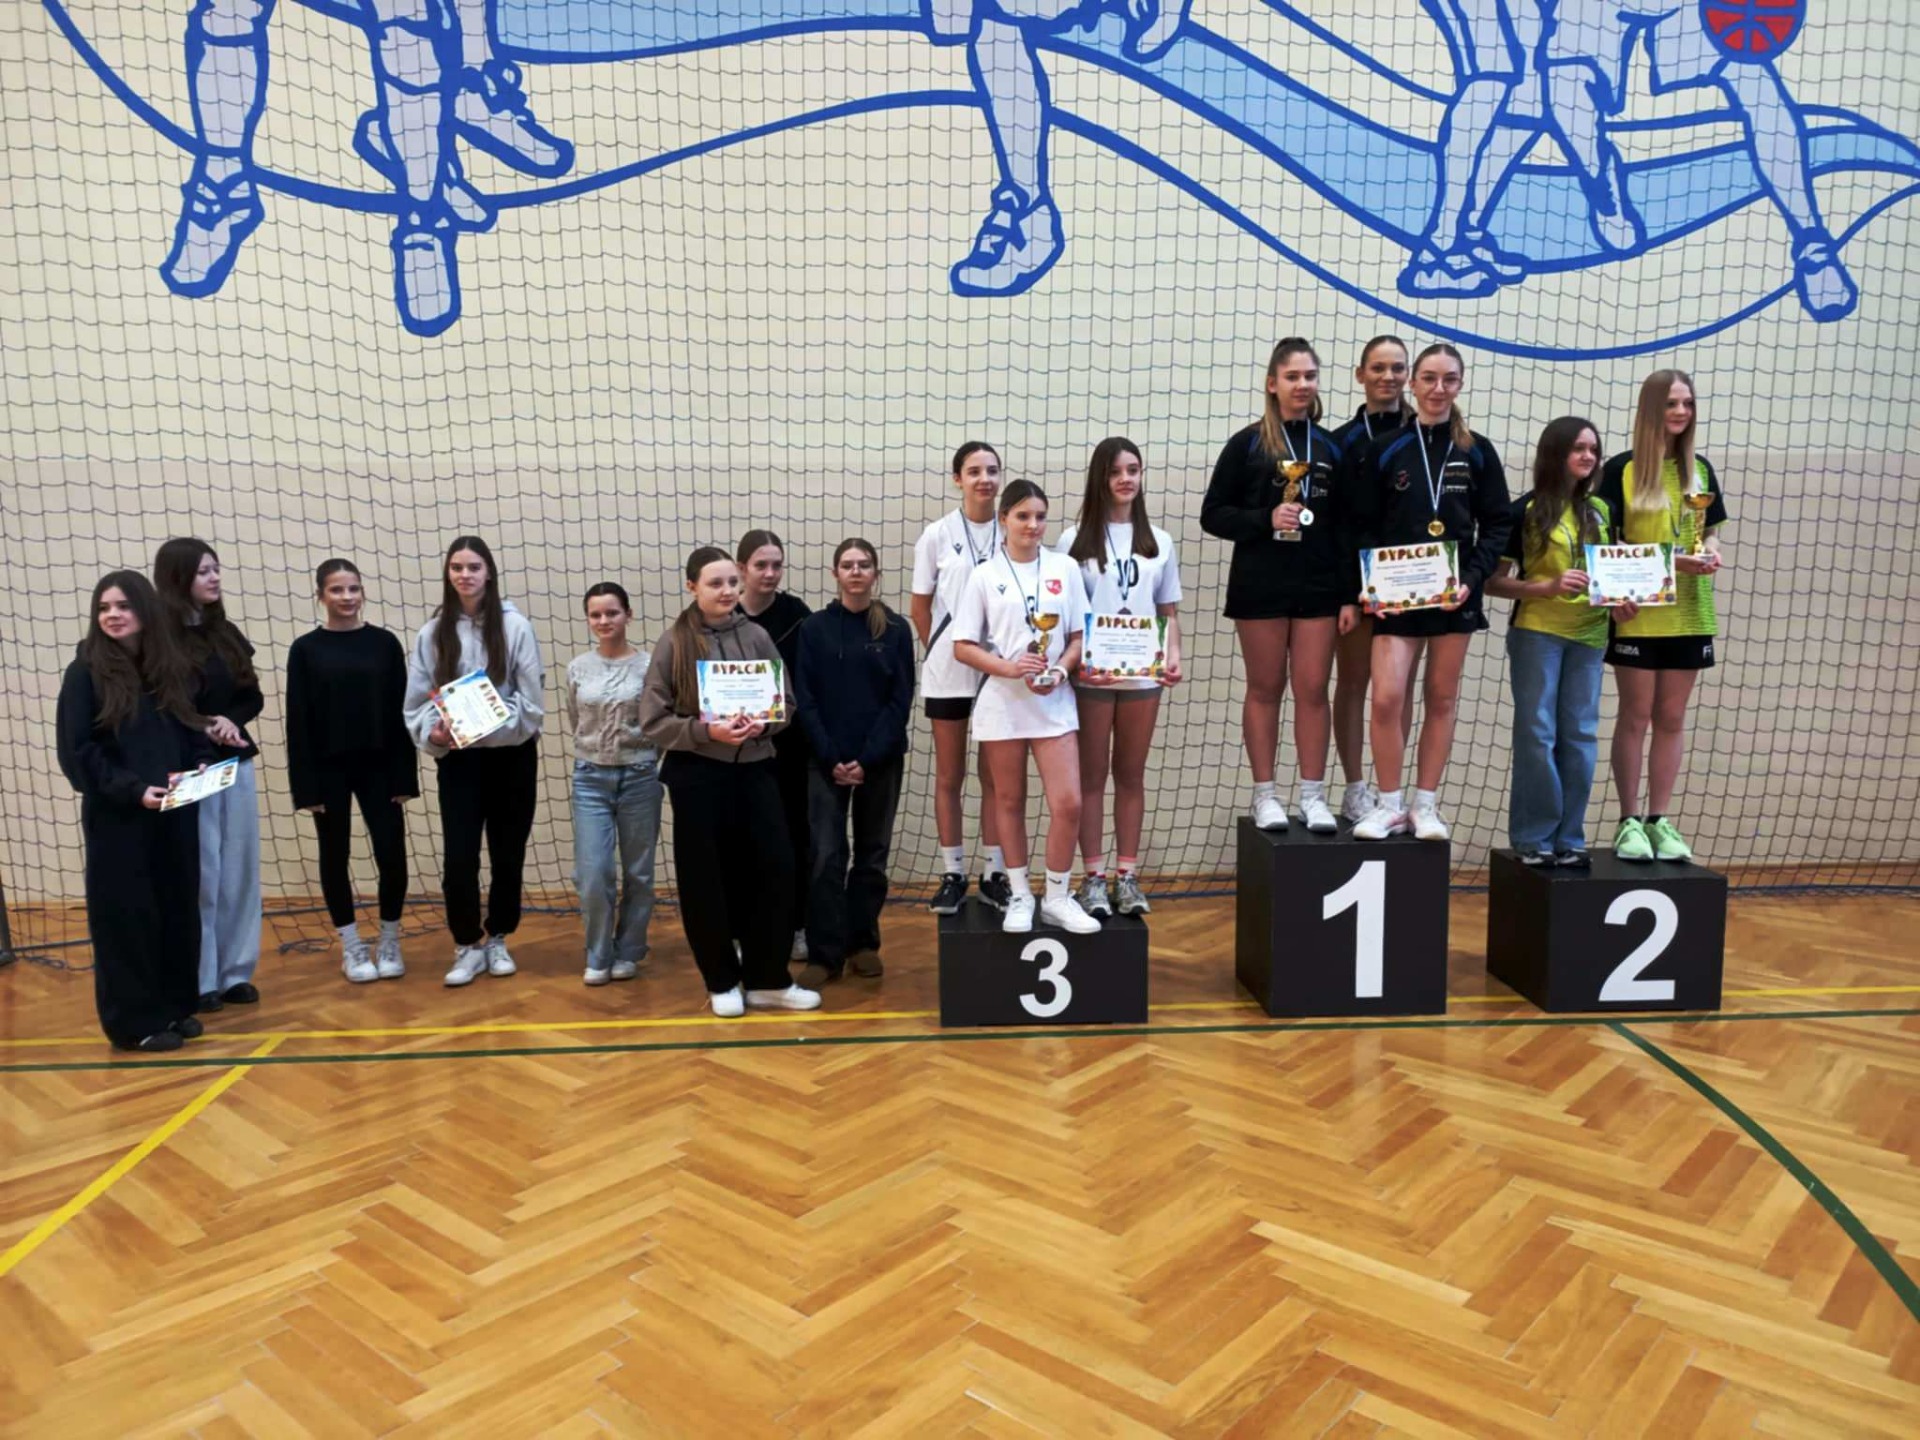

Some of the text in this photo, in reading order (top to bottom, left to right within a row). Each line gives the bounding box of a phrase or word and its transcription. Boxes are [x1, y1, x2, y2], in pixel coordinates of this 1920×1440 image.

[1019, 937, 1072, 1018] 3
[1322, 860, 1386, 998] 1
[1598, 889, 1679, 1002] 2
